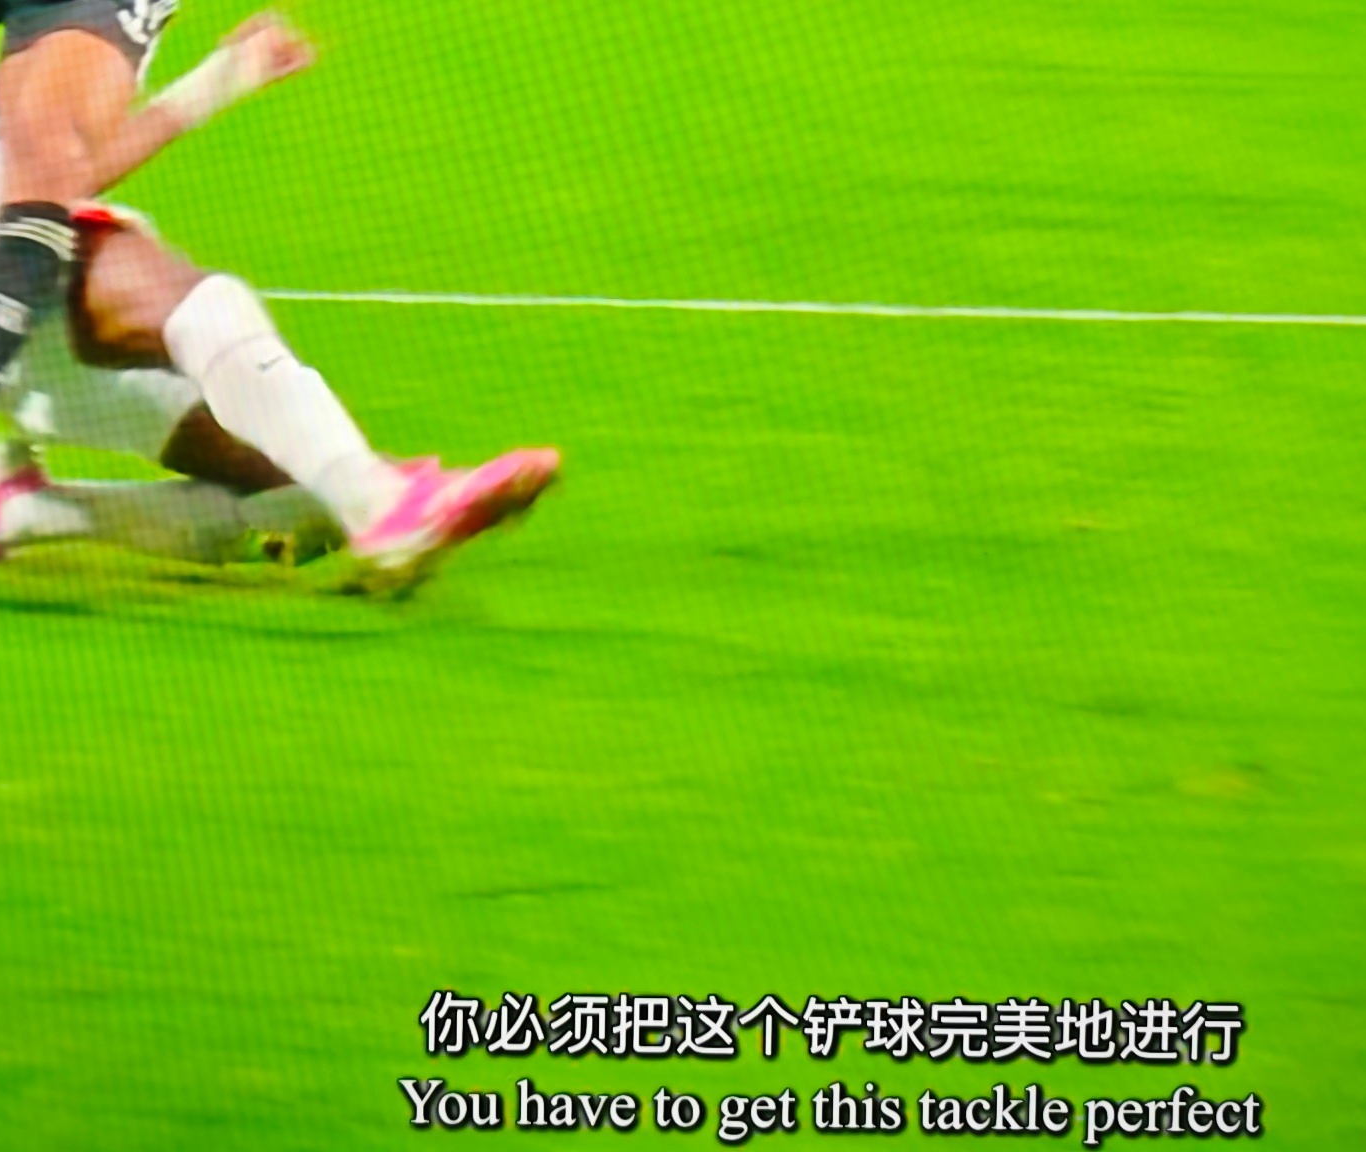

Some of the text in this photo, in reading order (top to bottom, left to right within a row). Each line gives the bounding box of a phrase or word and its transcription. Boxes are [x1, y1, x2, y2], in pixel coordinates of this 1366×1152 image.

[420, 990, 1243, 1064] 你必须把这个铲球完美地进行
[399, 1079, 1260, 1145] You have to get this tackle perfect
